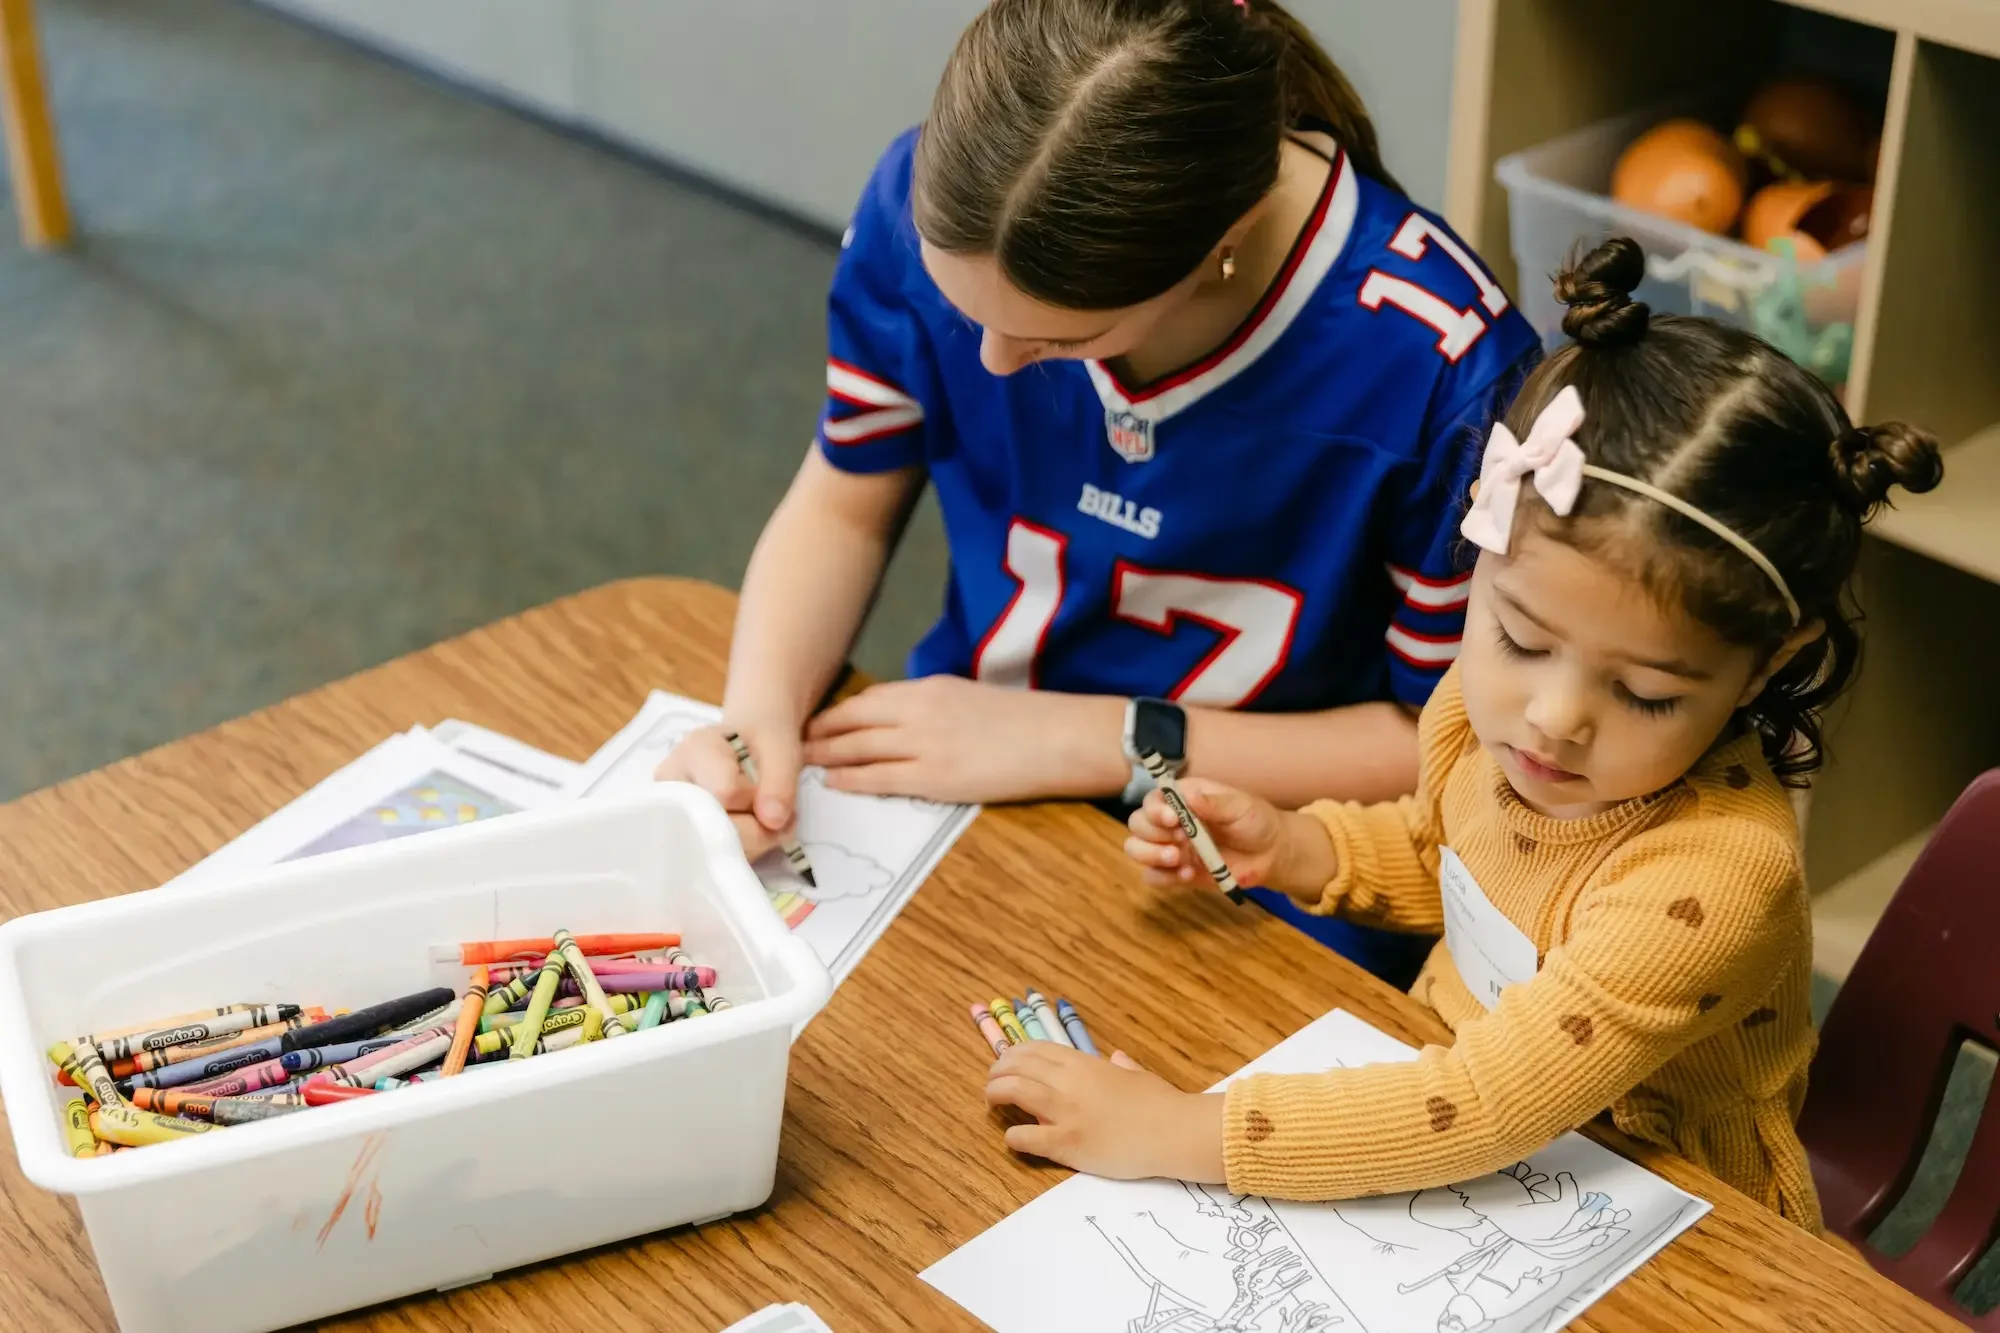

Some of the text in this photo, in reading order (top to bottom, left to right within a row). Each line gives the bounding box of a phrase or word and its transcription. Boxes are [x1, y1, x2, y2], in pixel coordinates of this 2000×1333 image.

[1358, 212, 1509, 365] 17
[1113, 430, 1147, 454] NFL
[1077, 483, 1163, 540] BILLS
[971, 515, 1306, 711] 17
[150, 1025, 207, 1048] Crayola
